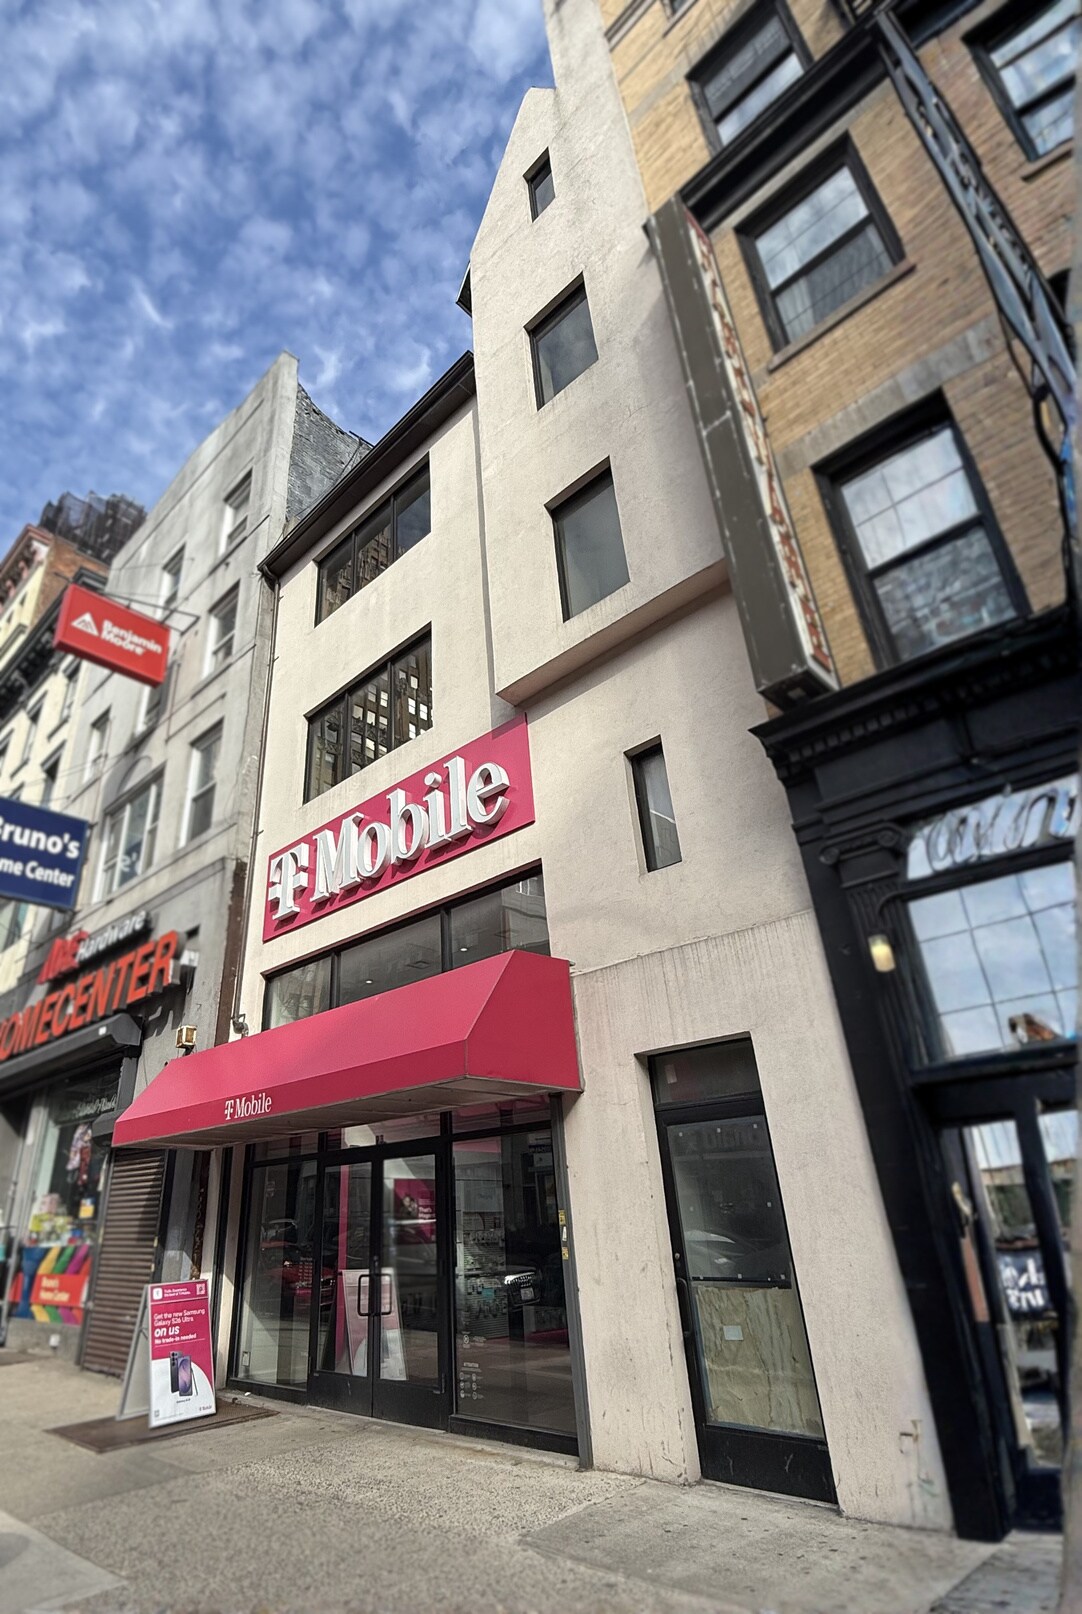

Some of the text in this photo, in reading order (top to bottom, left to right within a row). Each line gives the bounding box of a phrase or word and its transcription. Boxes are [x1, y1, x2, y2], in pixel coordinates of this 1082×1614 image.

[100, 629, 145, 656] Moore
[101, 619, 163, 655] Benjamin
[25, 860, 75, 888] Center
[75, 910, 147, 962] Hardware
[154, 1326, 180, 1337] on us
